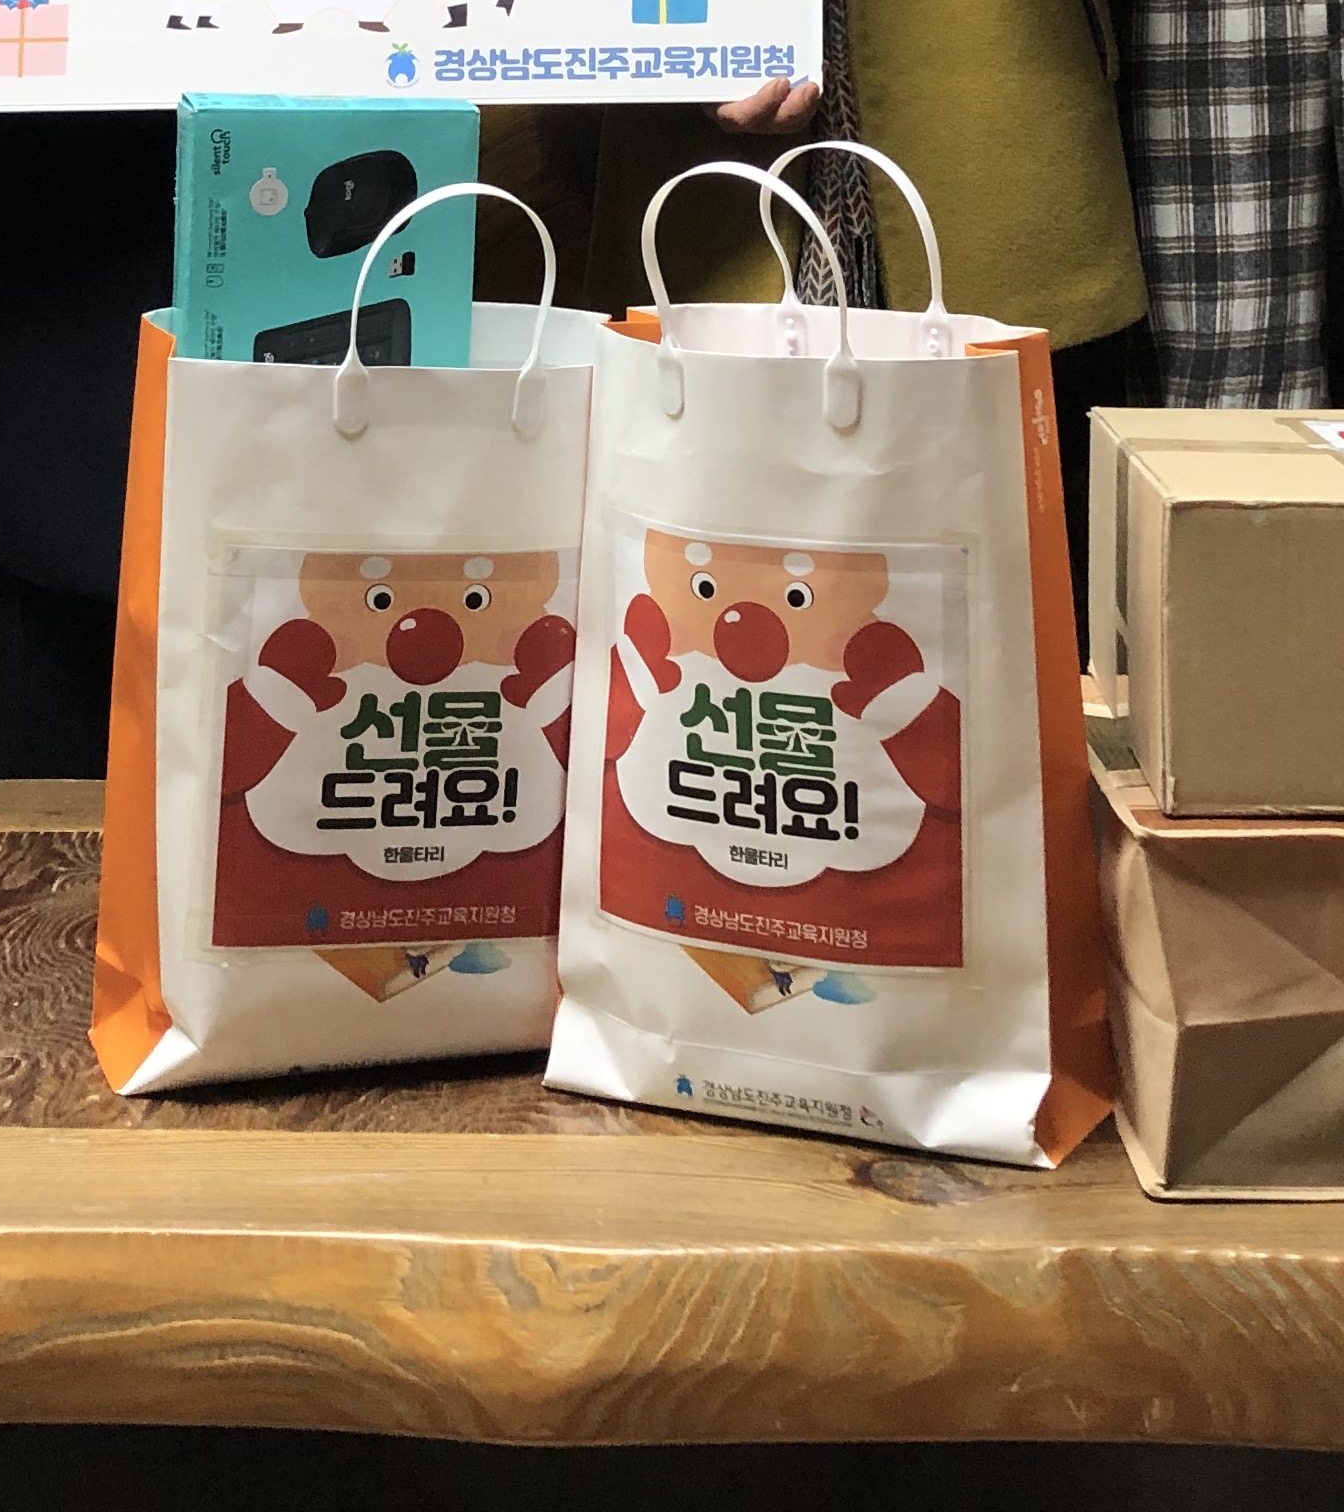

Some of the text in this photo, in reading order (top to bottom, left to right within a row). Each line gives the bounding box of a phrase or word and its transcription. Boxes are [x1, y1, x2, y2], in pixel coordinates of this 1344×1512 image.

[433, 44, 795, 81] 경상남도진주교육지원청
[211, 145, 221, 176] silent
[219, 130, 231, 165] touch
[343, 179, 355, 201] logi
[339, 690, 504, 772] 선물
[678, 682, 838, 780] 선물
[315, 767, 519, 830] 드려요!
[666, 758, 860, 841] 드려요!
[340, 905, 517, 930] 경상남도진주교육지원청
[694, 904, 868, 950] 경상남도진주교육지원청
[703, 1079, 853, 1122] 경상남도진주교육지원청
